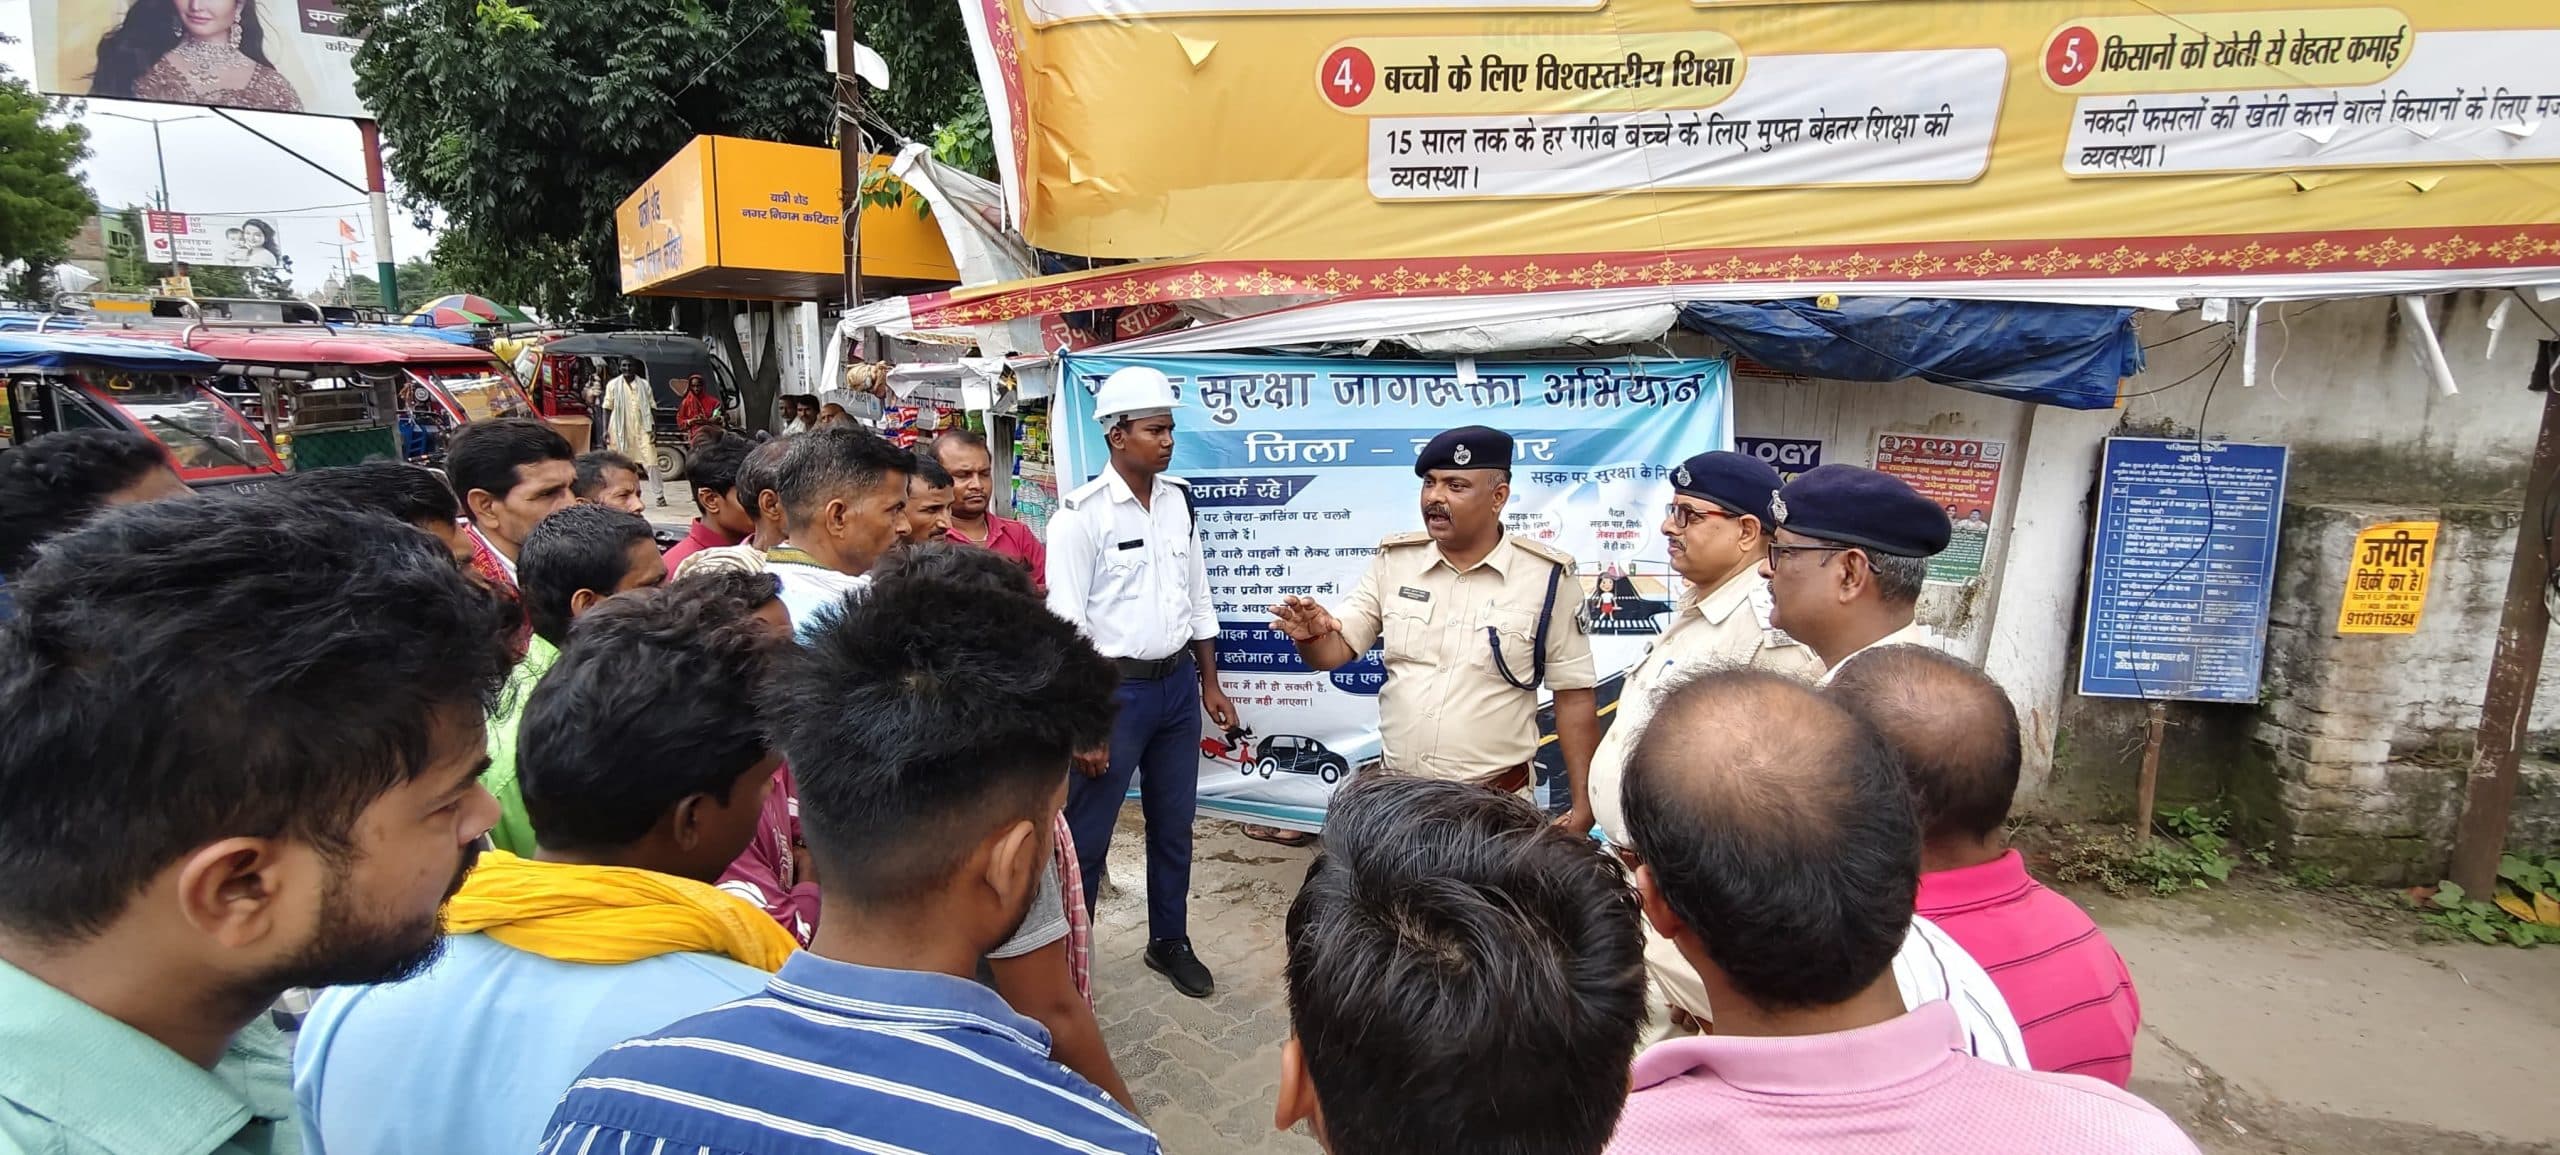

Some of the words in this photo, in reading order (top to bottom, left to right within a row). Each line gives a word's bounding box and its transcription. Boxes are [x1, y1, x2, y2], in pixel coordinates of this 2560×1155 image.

[2061, 38, 2083, 74] 5.
[2101, 33, 2177, 72] किसानों
[2181, 32, 2209, 69] को
[2213, 29, 2261, 68] खेती
[2265, 28, 2287, 66] से
[2290, 25, 2343, 66] बेहतर
[2347, 24, 2403, 69] कमाई
[1332, 58, 1362, 95] 4.
[1383, 55, 1440, 93] बच्चों
[1448, 55, 1472, 92] के
[1480, 54, 1528, 92] लिए
[1536, 52, 1664, 91] विश्वस्तरीय
[1672, 49, 1736, 87] शिक्षा
[2084, 99, 2139, 136] नकदी
[2143, 97, 2209, 132] फसलों
[2211, 95, 2239, 130] की
[2245, 93, 2290, 128] खेती
[2294, 90, 2338, 126] करने
[2343, 89, 2386, 124] वाले
[2391, 87, 2465, 123] किसानों
[2465, 86, 2488, 120] के
[2490, 86, 2532, 126] लिए
[1387, 130, 1412, 155] 15
[1421, 128, 1467, 156] साल
[1473, 127, 1509, 154] तक
[1513, 117, 1536, 152] के
[1542, 127, 1567, 156] हर
[1570, 117, 1619, 150] गरीब
[1624, 114, 1673, 148] बच्चे
[1678, 112, 1702, 147] के
[1707, 112, 1751, 151] लिए
[1757, 118, 1803, 153] मुफ्त
[1809, 108, 1863, 144] बेहतर
[1866, 107, 1919, 144] शिक्षा
[1924, 103, 1954, 138] की
[770, 191, 790, 204] यात्री
[742, 208, 767, 219] नगर
[769, 207, 799, 221] निगम
[803, 211, 839, 224] कटिहार
[1197, 373, 1316, 425] सुरक्षा
[1544, 366, 1707, 409] अभियान
[1244, 432, 1355, 464] जिला
[1531, 471, 1567, 487] सड़क
[1572, 471, 1589, 483] पर
[1594, 466, 1636, 484] सुरक्षा
[1640, 462, 1654, 479] के
[1193, 478, 1248, 499] सतर्क
[1204, 512, 1220, 523] पर
[1303, 511, 1319, 522] पर
[1322, 509, 1352, 521] चलने
[1214, 529, 1239, 541] जाने
[1220, 546, 1243, 559] वाले
[1247, 545, 1280, 559] वाहनों
[1285, 546, 1299, 557] को
[1304, 546, 1330, 557] लेकर
[2362, 530, 2429, 568] जमीन
[1207, 566, 1229, 578] गति
[1233, 565, 1260, 577] धीमी
[1223, 586, 1236, 596] का
[1240, 583, 1273, 596] प्रयोग
[1278, 585, 1312, 596] अवश्य
[2388, 574, 2407, 592] का
[1252, 629, 1269, 642] या
[1224, 648, 1273, 665] इस्तेमाल
[1278, 652, 1290, 664] न
[1242, 680, 1251, 690] में
[1255, 680, 1267, 691] भी
[1271, 680, 1280, 691] हो
[1284, 680, 1313, 691] सकती
[1334, 673, 1353, 685] वह
[1360, 672, 1382, 684] एक
